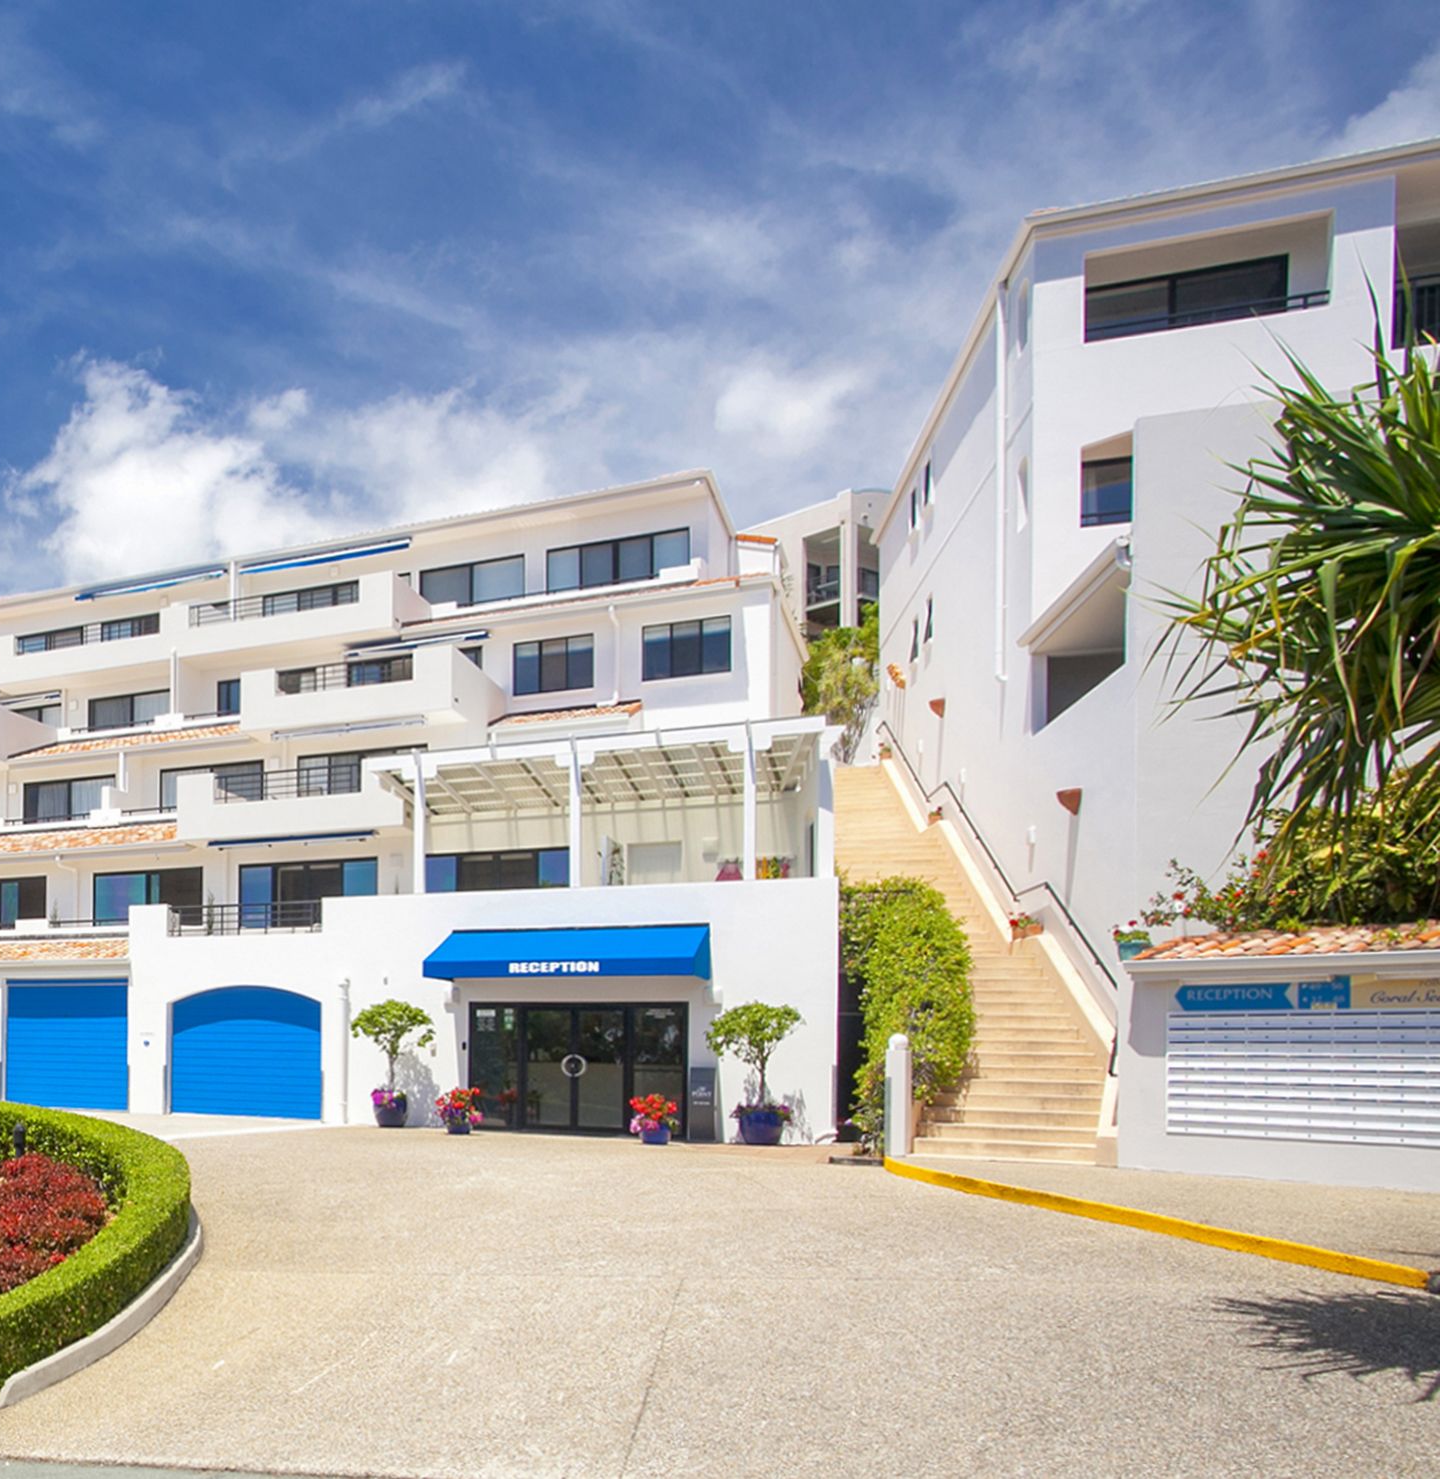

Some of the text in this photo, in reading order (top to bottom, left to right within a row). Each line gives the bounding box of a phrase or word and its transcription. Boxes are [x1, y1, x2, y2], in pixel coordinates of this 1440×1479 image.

[508, 961, 600, 974] RECEPTION
[1186, 987, 1274, 1001] RECEPTION
[1369, 989, 1417, 1004] Coral
